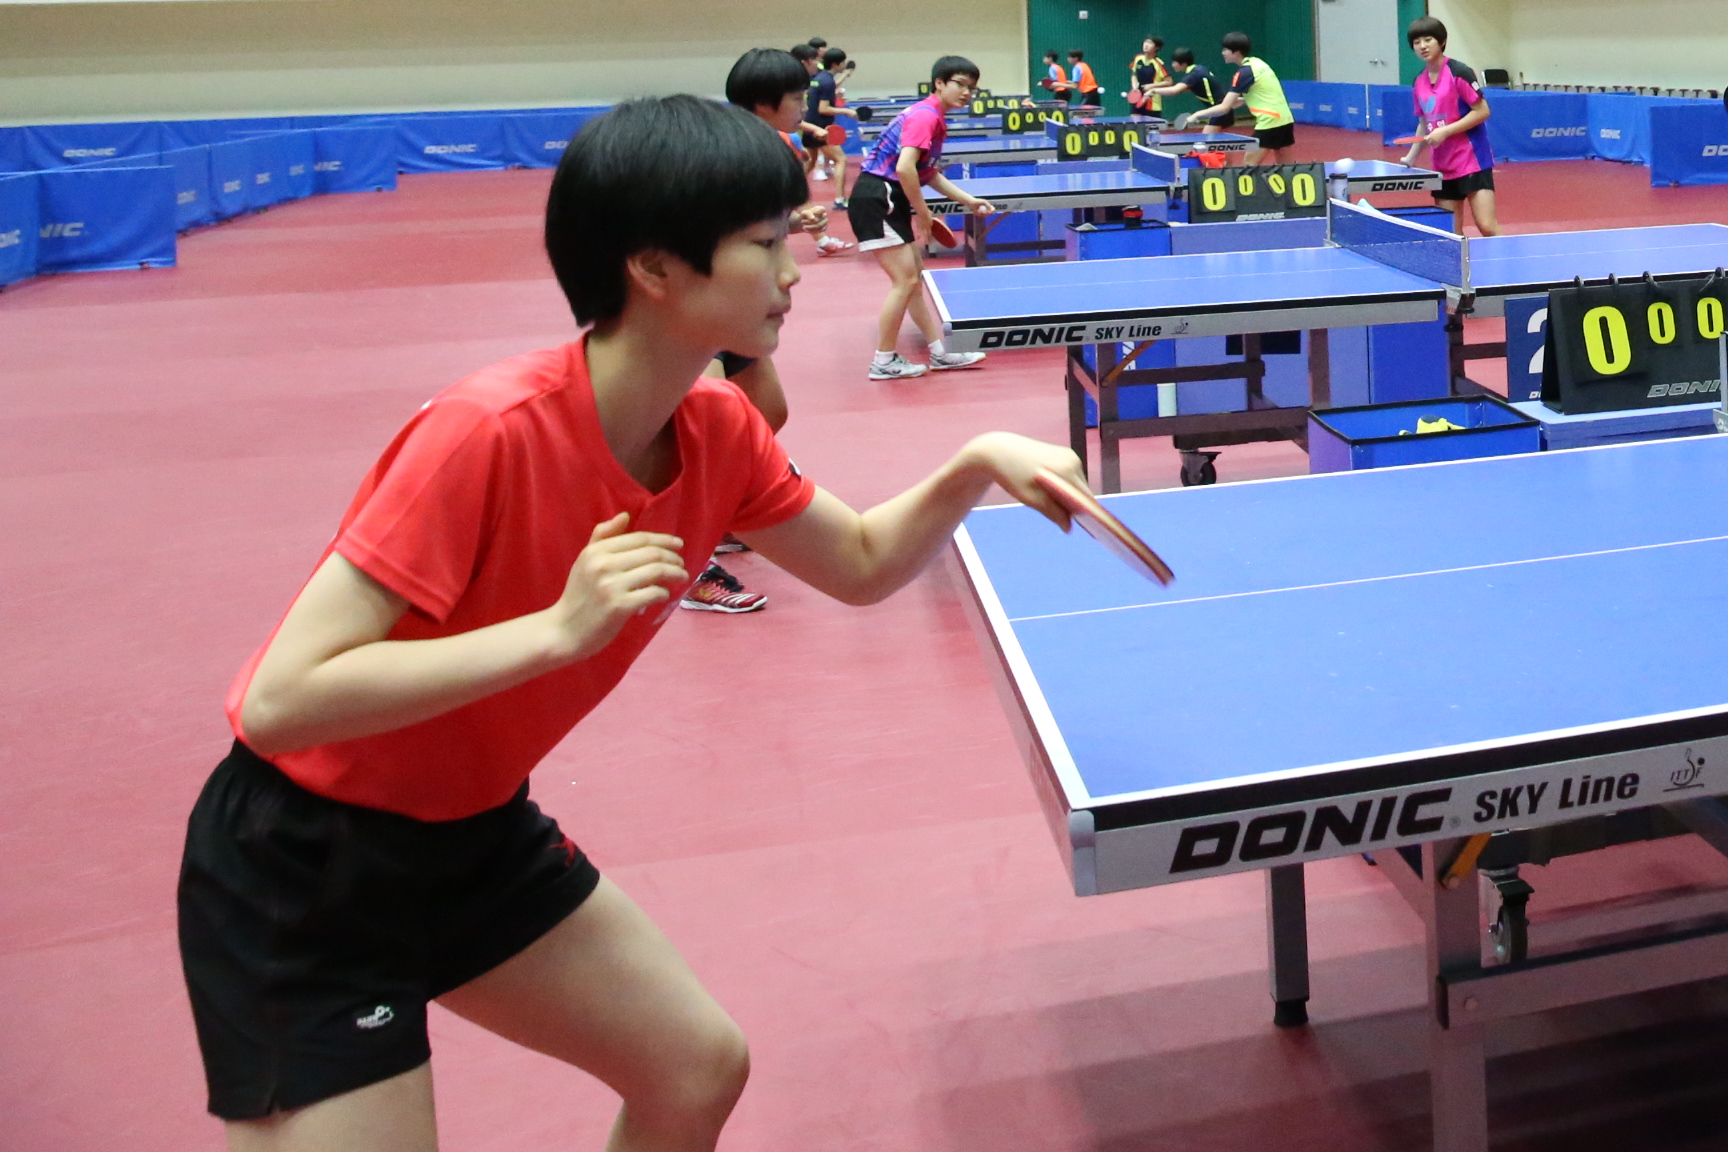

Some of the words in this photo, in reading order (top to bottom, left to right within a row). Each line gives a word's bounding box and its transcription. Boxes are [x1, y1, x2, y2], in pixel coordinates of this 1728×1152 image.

[1008, 112, 1021, 131] 0
[1531, 127, 1588, 137] DONIC
[1065, 132, 1082, 155] 0
[1088, 131, 1099, 146] 0
[1104, 130, 1115, 145] 0
[1202, 177, 1226, 211] 0
[1238, 174, 1253, 195] 0
[1268, 173, 1285, 194] 0
[1292, 173, 1316, 206] 0
[1371, 181, 1424, 192] DONIC
[979, 325, 1086, 348] DONIC
[1095, 326, 1125, 340] SKY
[1128, 324, 1162, 337] Line
[1582, 306, 1632, 375] 0
[1647, 302, 1676, 344] 0
[1696, 297, 1724, 339] 0
[1169, 788, 1453, 874] DONIC
[1473, 782, 1548, 823] SKY
[1559, 771, 1640, 810] Line
